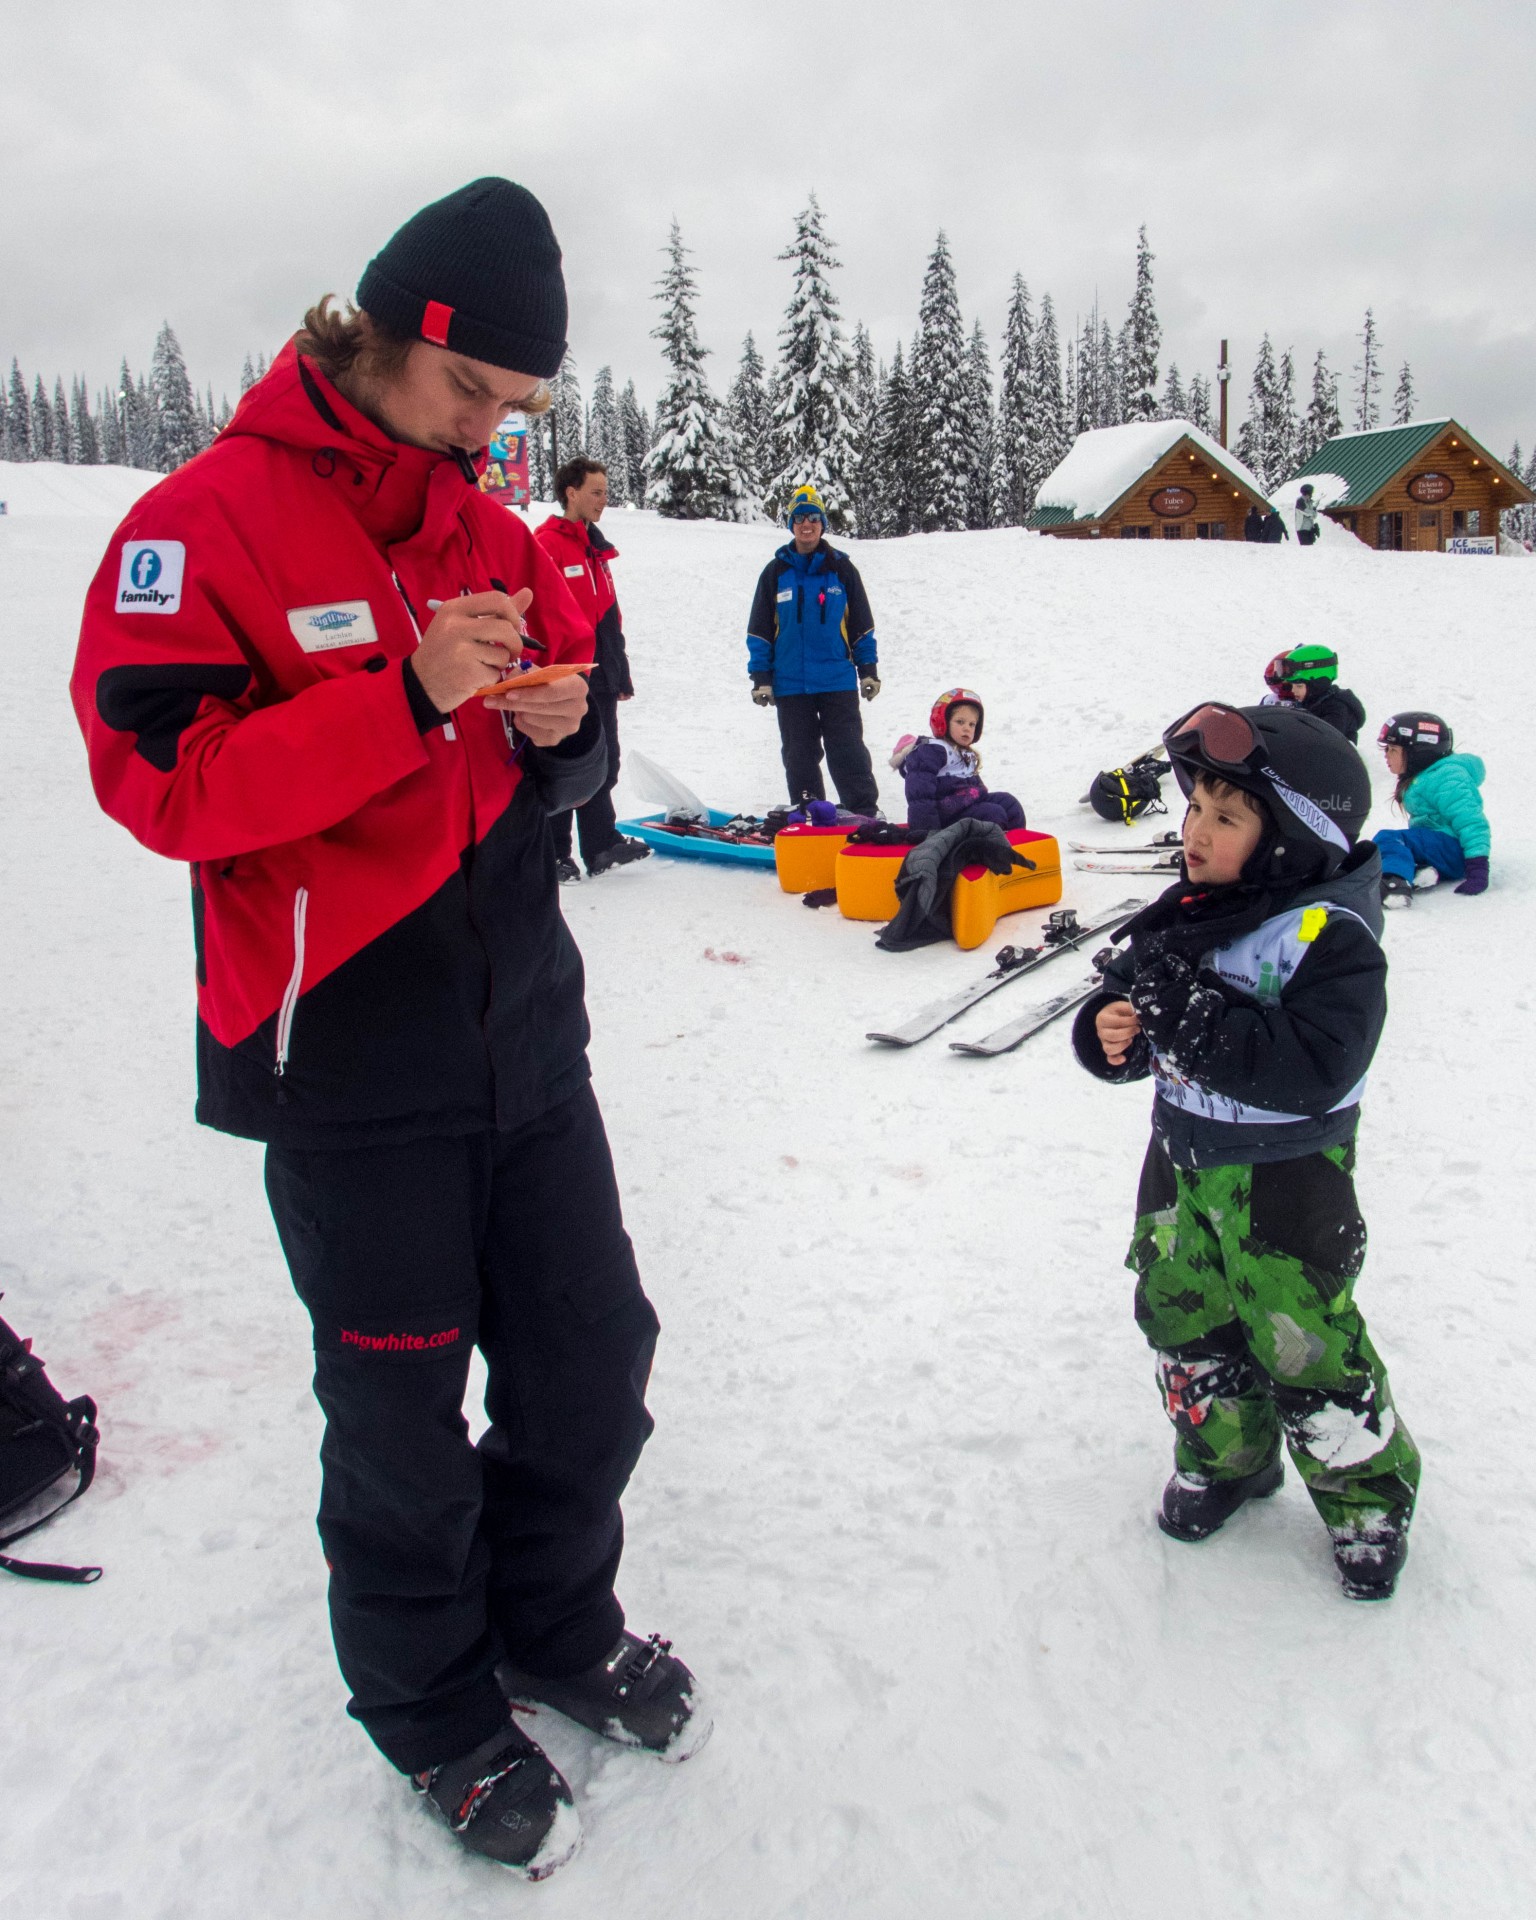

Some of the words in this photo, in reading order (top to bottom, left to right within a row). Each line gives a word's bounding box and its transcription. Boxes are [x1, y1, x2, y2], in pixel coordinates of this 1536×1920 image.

[1164, 497, 1184, 505] Tubes
[1452, 539, 1468, 548] ICE
[1219, 969, 1257, 988] amily
